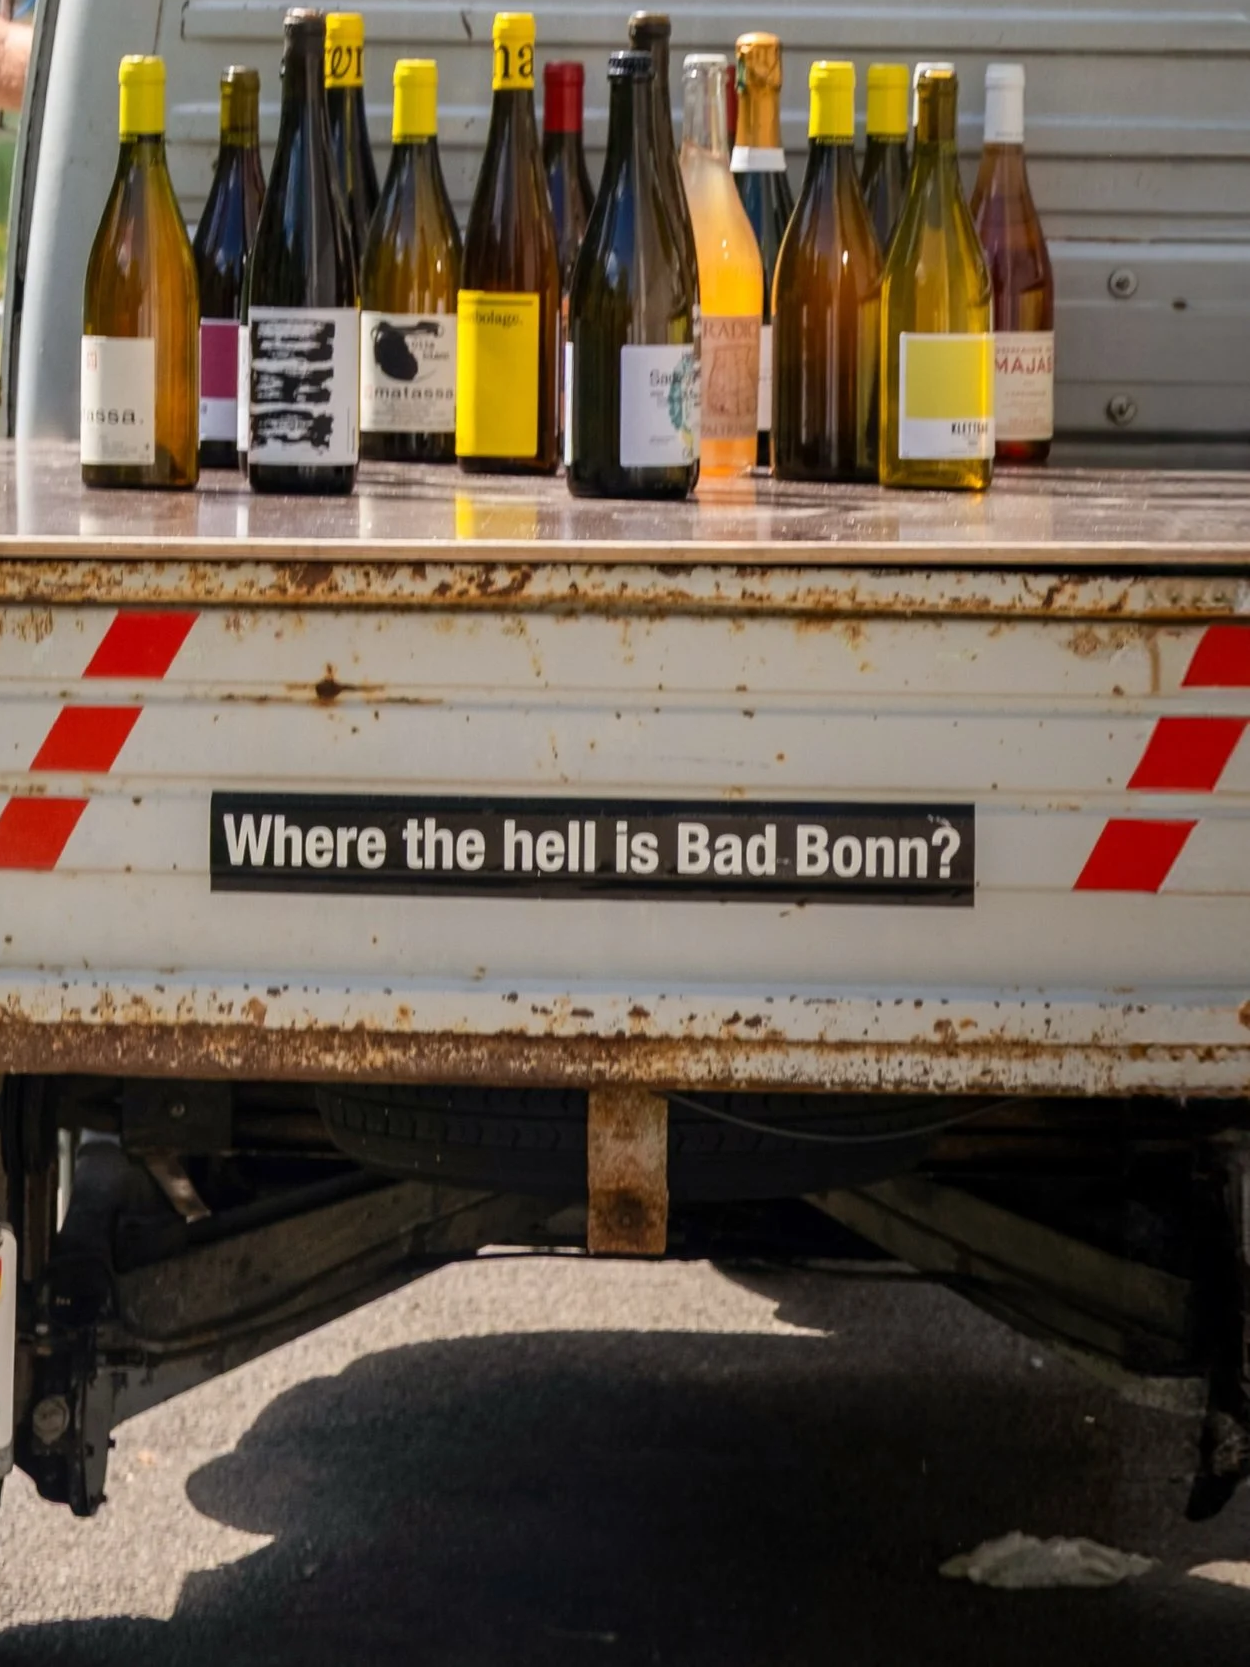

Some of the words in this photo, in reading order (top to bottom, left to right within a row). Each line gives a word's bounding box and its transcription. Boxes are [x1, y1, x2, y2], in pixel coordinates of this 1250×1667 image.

[223, 813, 387, 869] Where
[402, 816, 485, 871] the
[504, 819, 596, 873] hell
[615, 820, 659, 875] is
[677, 823, 777, 878] Bad
[796, 824, 961, 880] Bonn?
